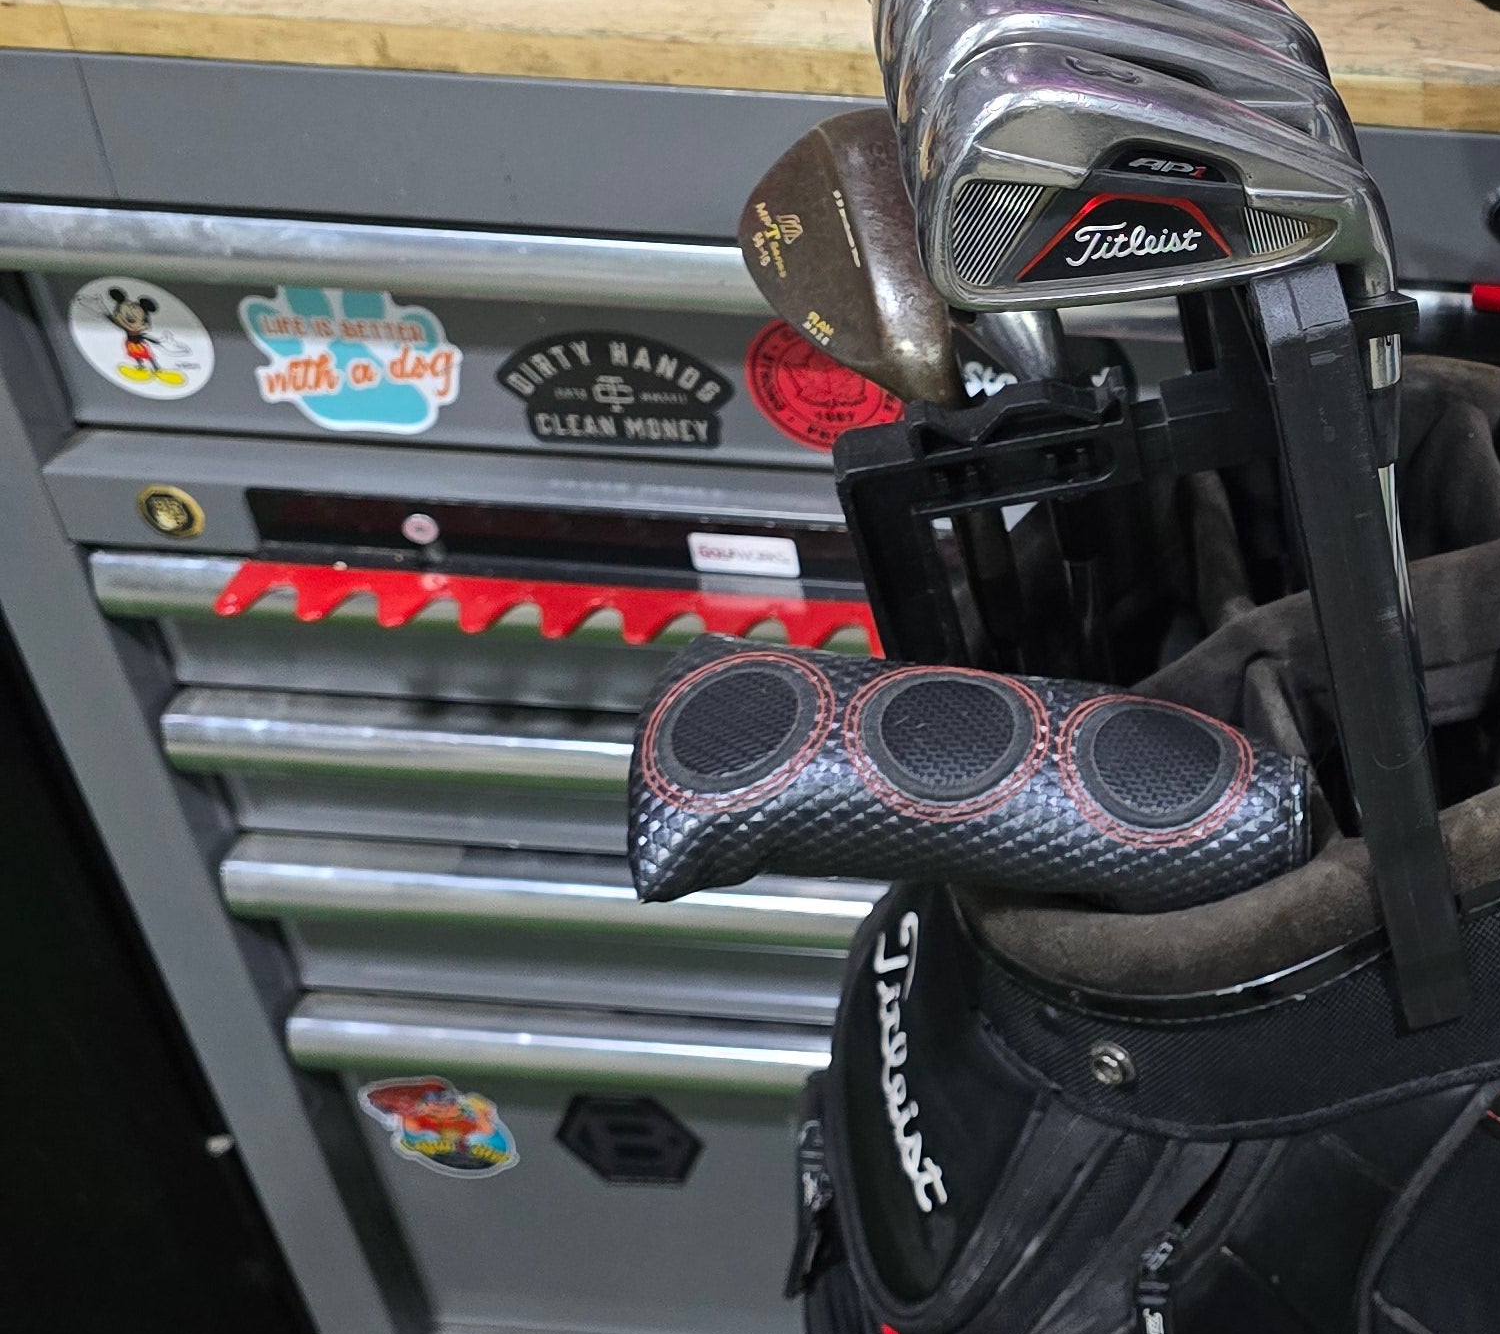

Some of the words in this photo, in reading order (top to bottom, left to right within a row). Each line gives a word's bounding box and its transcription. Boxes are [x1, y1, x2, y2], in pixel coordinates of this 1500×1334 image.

[1128, 157, 1207, 179] AP1
[1066, 221, 1202, 267] Titleist
[261, 316, 306, 336] LIFE
[313, 318, 334, 337] IS
[340, 320, 424, 342] BETTER
[266, 353, 340, 393] with
[351, 363, 375, 384] a
[389, 344, 455, 397] dog
[506, 340, 592, 397] DIRTY
[608, 340, 722, 404] HANDS
[534, 412, 618, 438] CLEAN
[623, 416, 709, 443] MONEY
[874, 910, 948, 1213] Titleist
